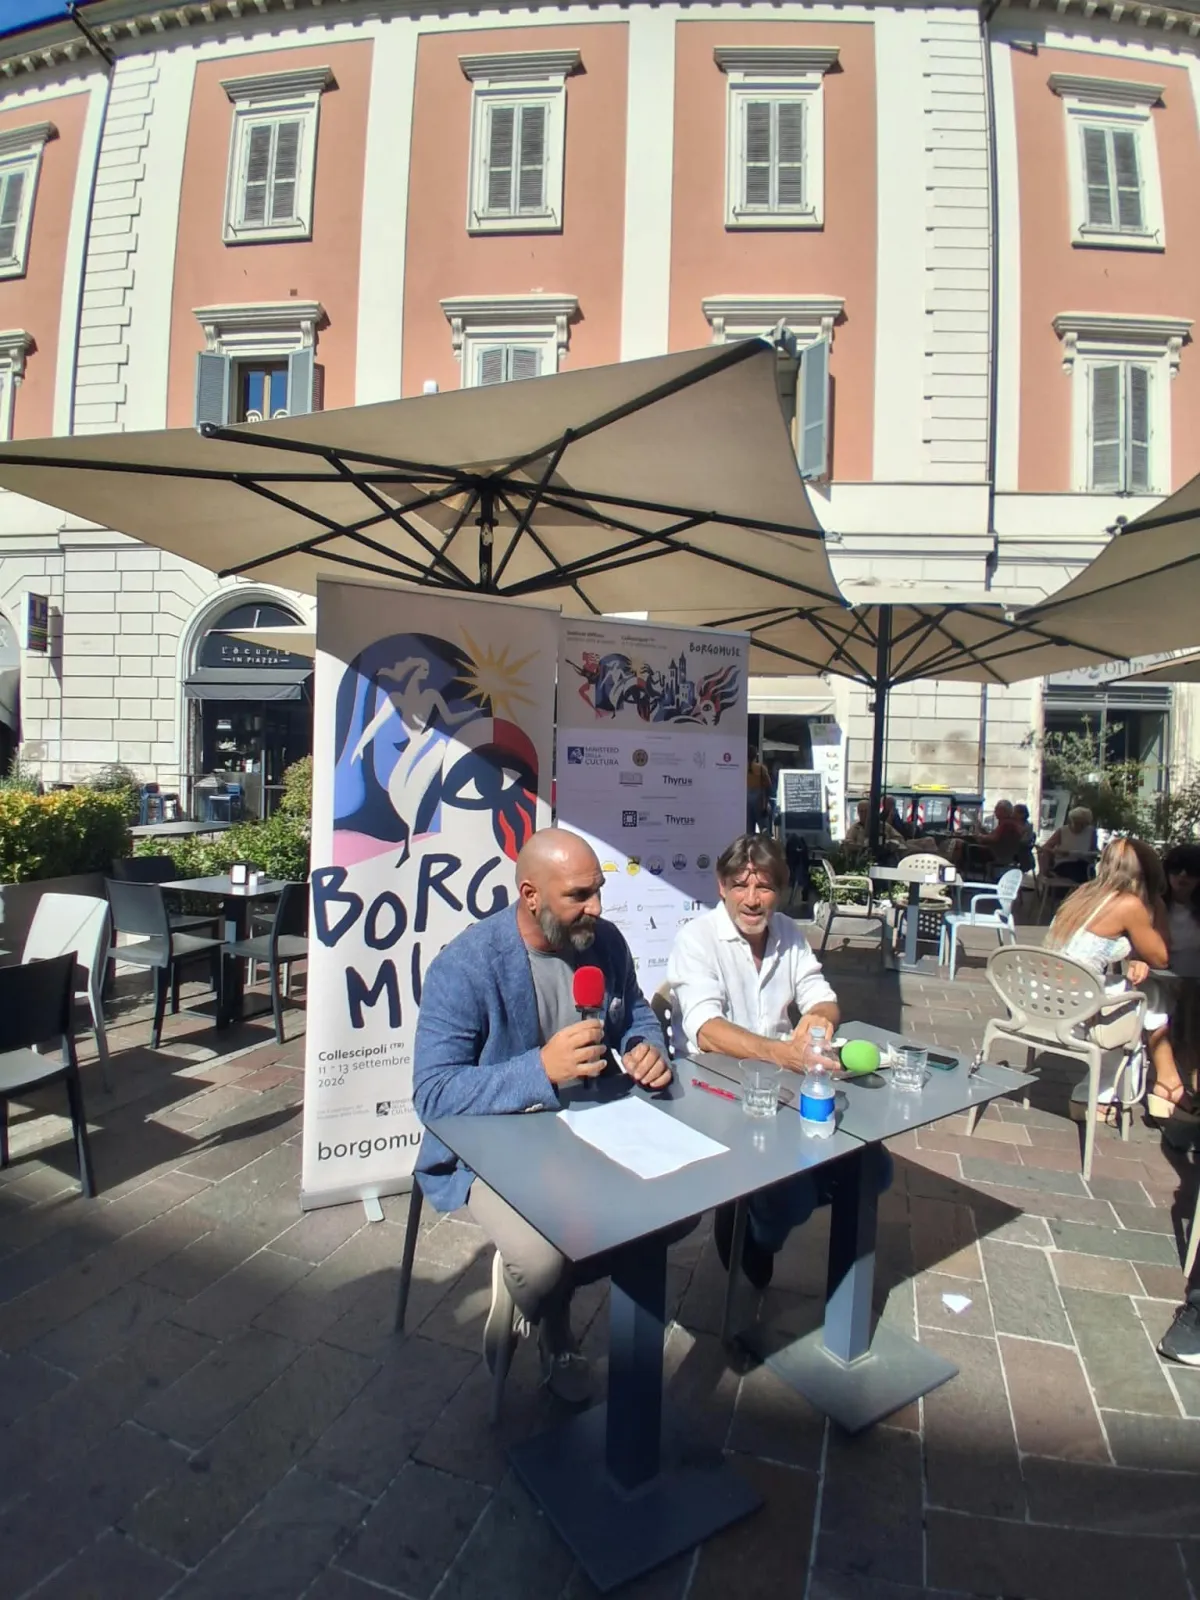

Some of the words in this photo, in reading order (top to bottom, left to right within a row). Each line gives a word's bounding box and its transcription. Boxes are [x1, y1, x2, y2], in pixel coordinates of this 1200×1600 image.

[689, 642, 741, 657] BORGOMUSE
[247, 656, 279, 664] PIAZZA
[585, 758, 619, 766] CULTURA
[318, 1044, 387, 1061] Collescipoli
[339, 1064, 349, 1075] 13
[352, 1055, 411, 1070] settembre
[318, 1075, 345, 1088] 2026
[318, 1131, 421, 1161] borgomu
